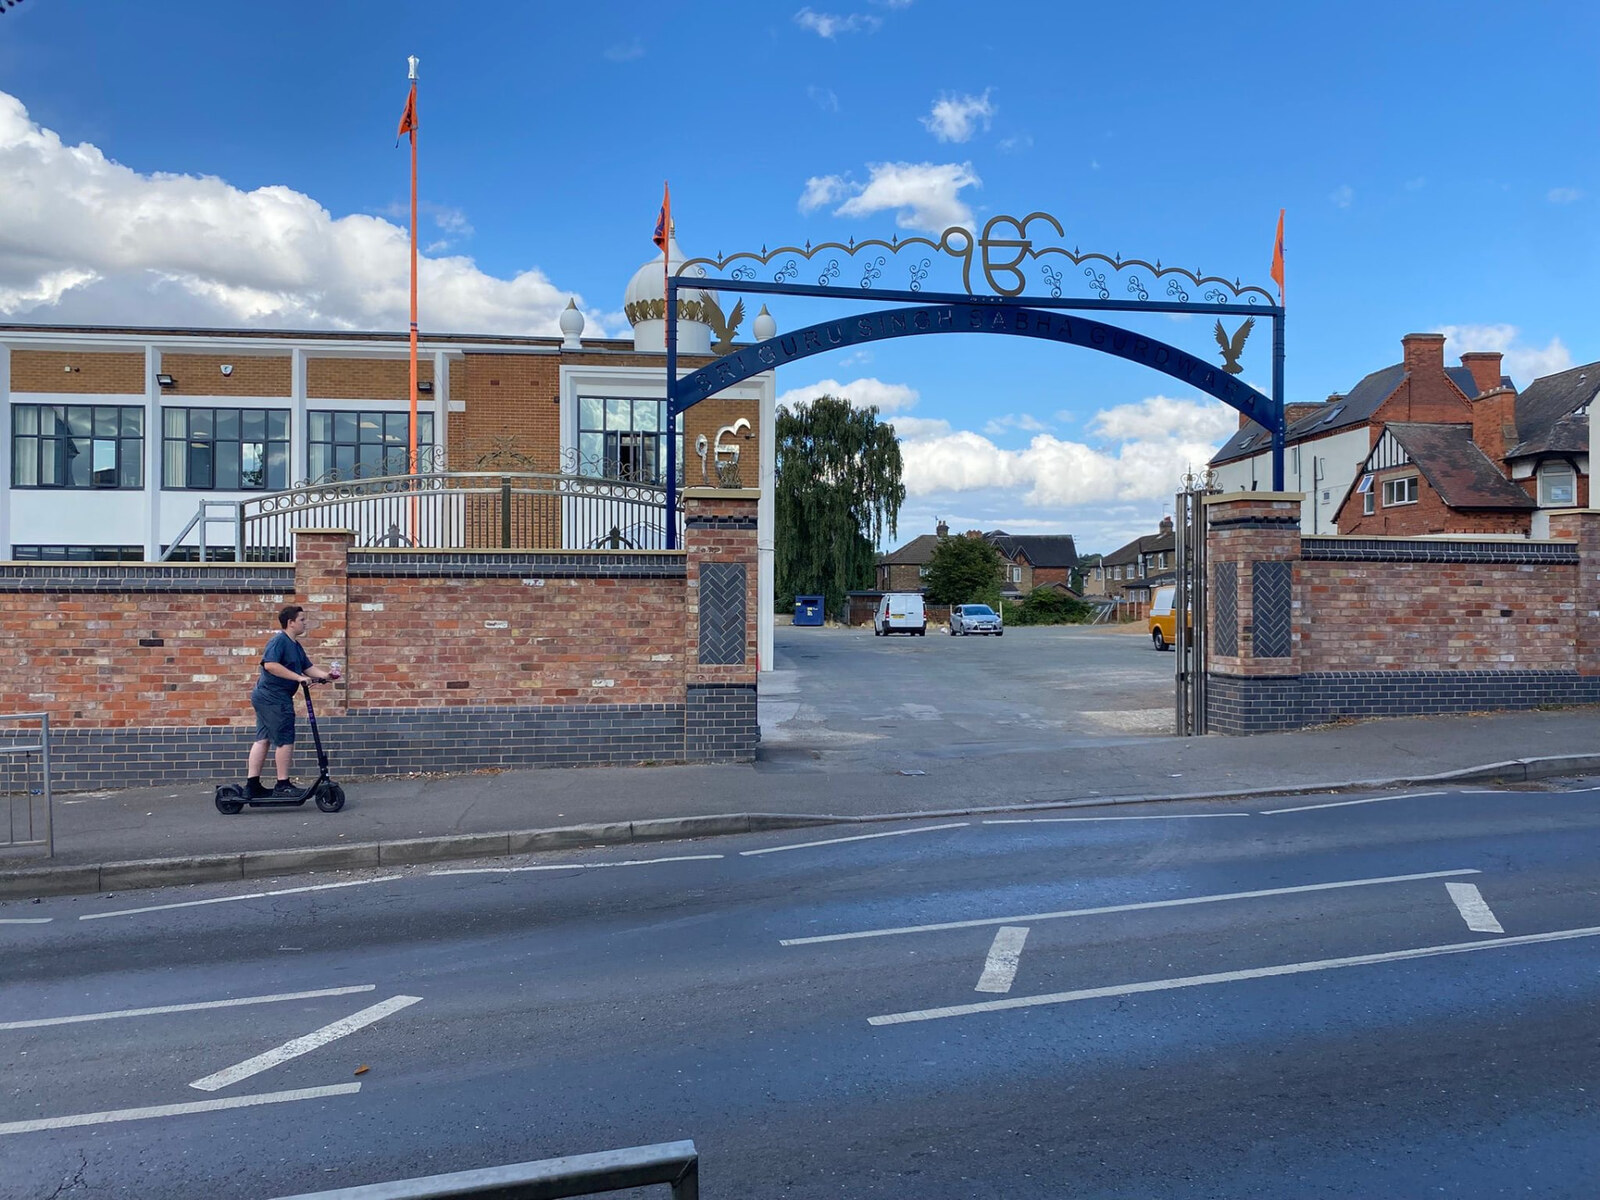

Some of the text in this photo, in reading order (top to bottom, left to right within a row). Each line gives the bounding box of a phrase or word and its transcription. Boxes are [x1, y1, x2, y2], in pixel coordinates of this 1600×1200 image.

[695, 308, 1257, 412] SRI GURU SINGH SABHA GURDWARA
